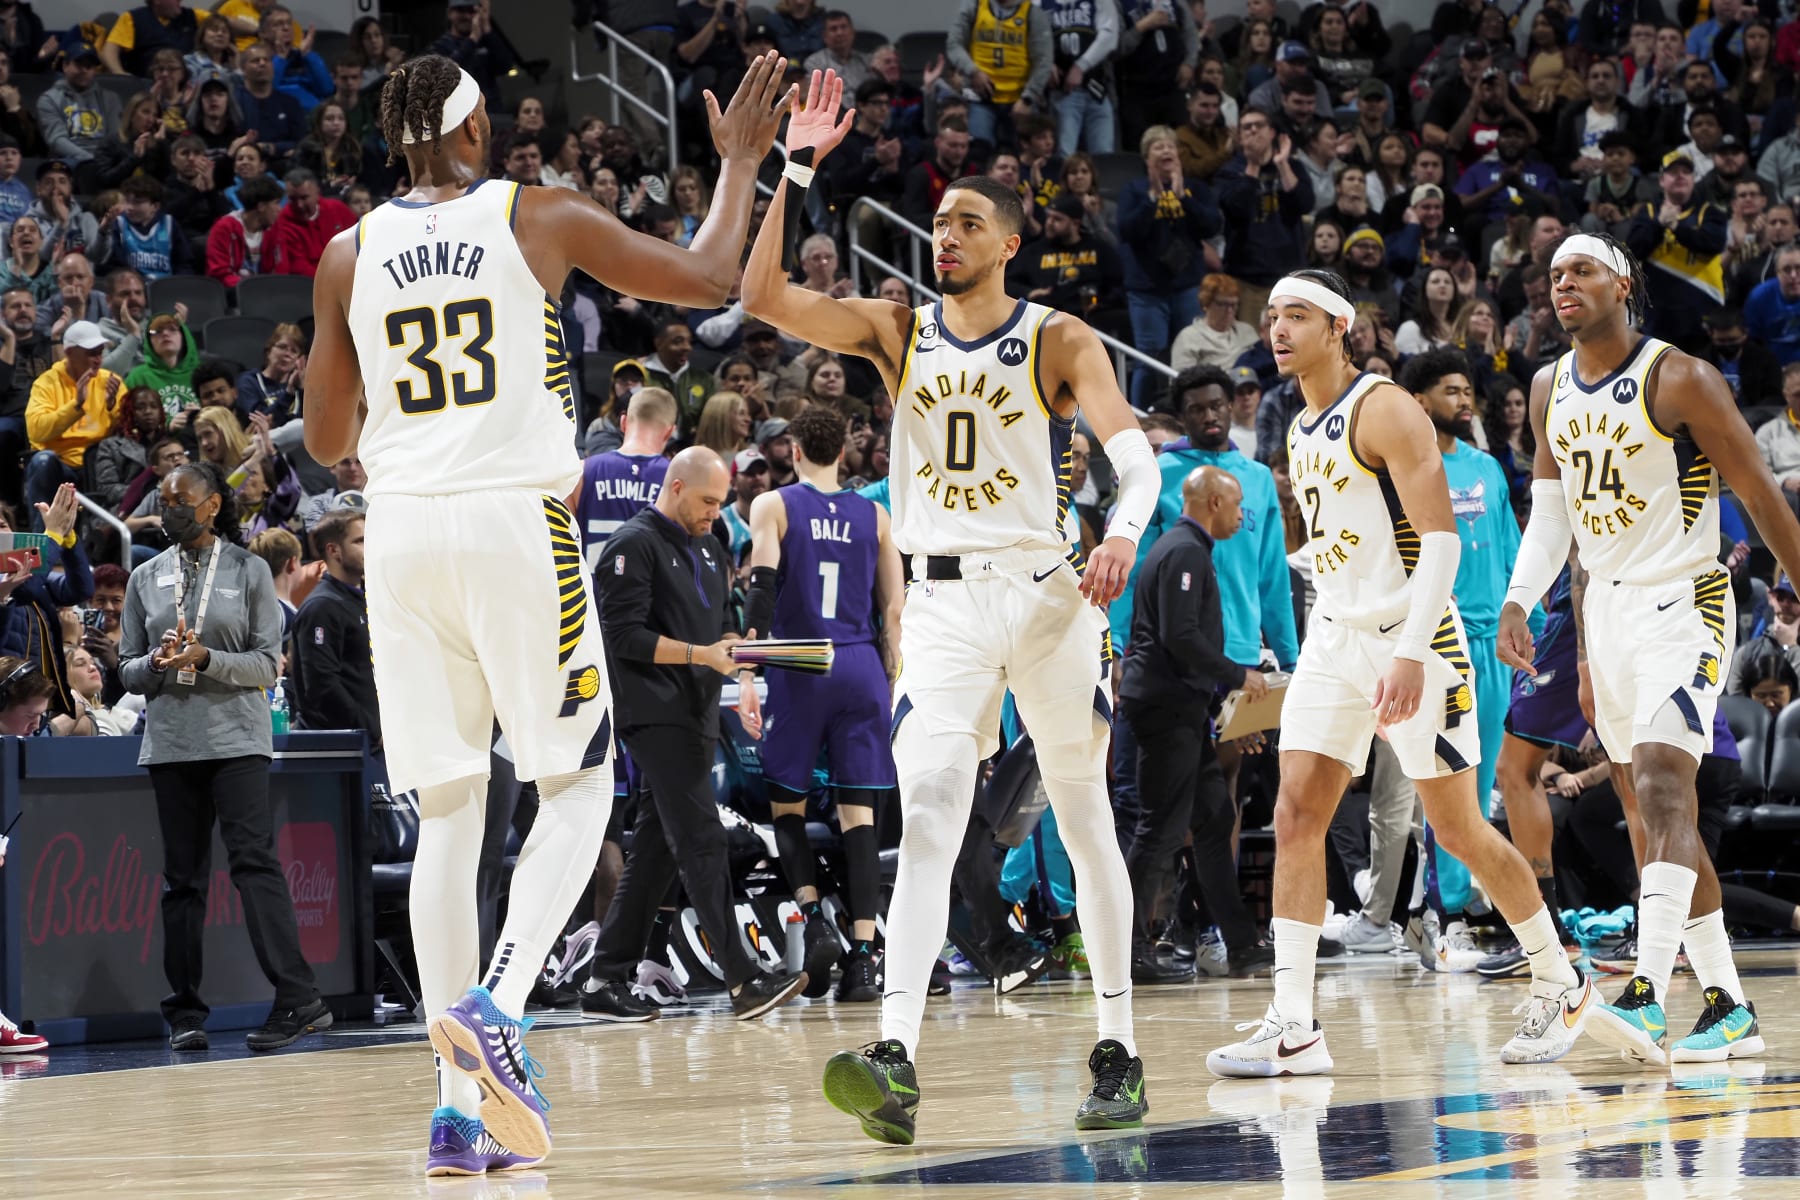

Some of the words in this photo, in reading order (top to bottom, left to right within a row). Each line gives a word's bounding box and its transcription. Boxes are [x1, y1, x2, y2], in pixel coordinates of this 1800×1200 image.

[382, 241, 485, 290] TURNER
[385, 296, 497, 417] 33
[912, 370, 1025, 430] INDIANA
[945, 411, 977, 472] 0
[1555, 413, 1644, 465] INDIANA
[595, 479, 664, 502] PLUMLE
[916, 461, 1020, 512] PACERS
[1291, 451, 1350, 495] DIANA
[1571, 449, 1625, 501] 24
[810, 518, 852, 544] BALL
[1305, 486, 1326, 540] 2
[1315, 528, 1360, 574] CERS
[818, 561, 840, 619] 1
[27, 831, 162, 965] Bally
[285, 860, 335, 913] Bally
